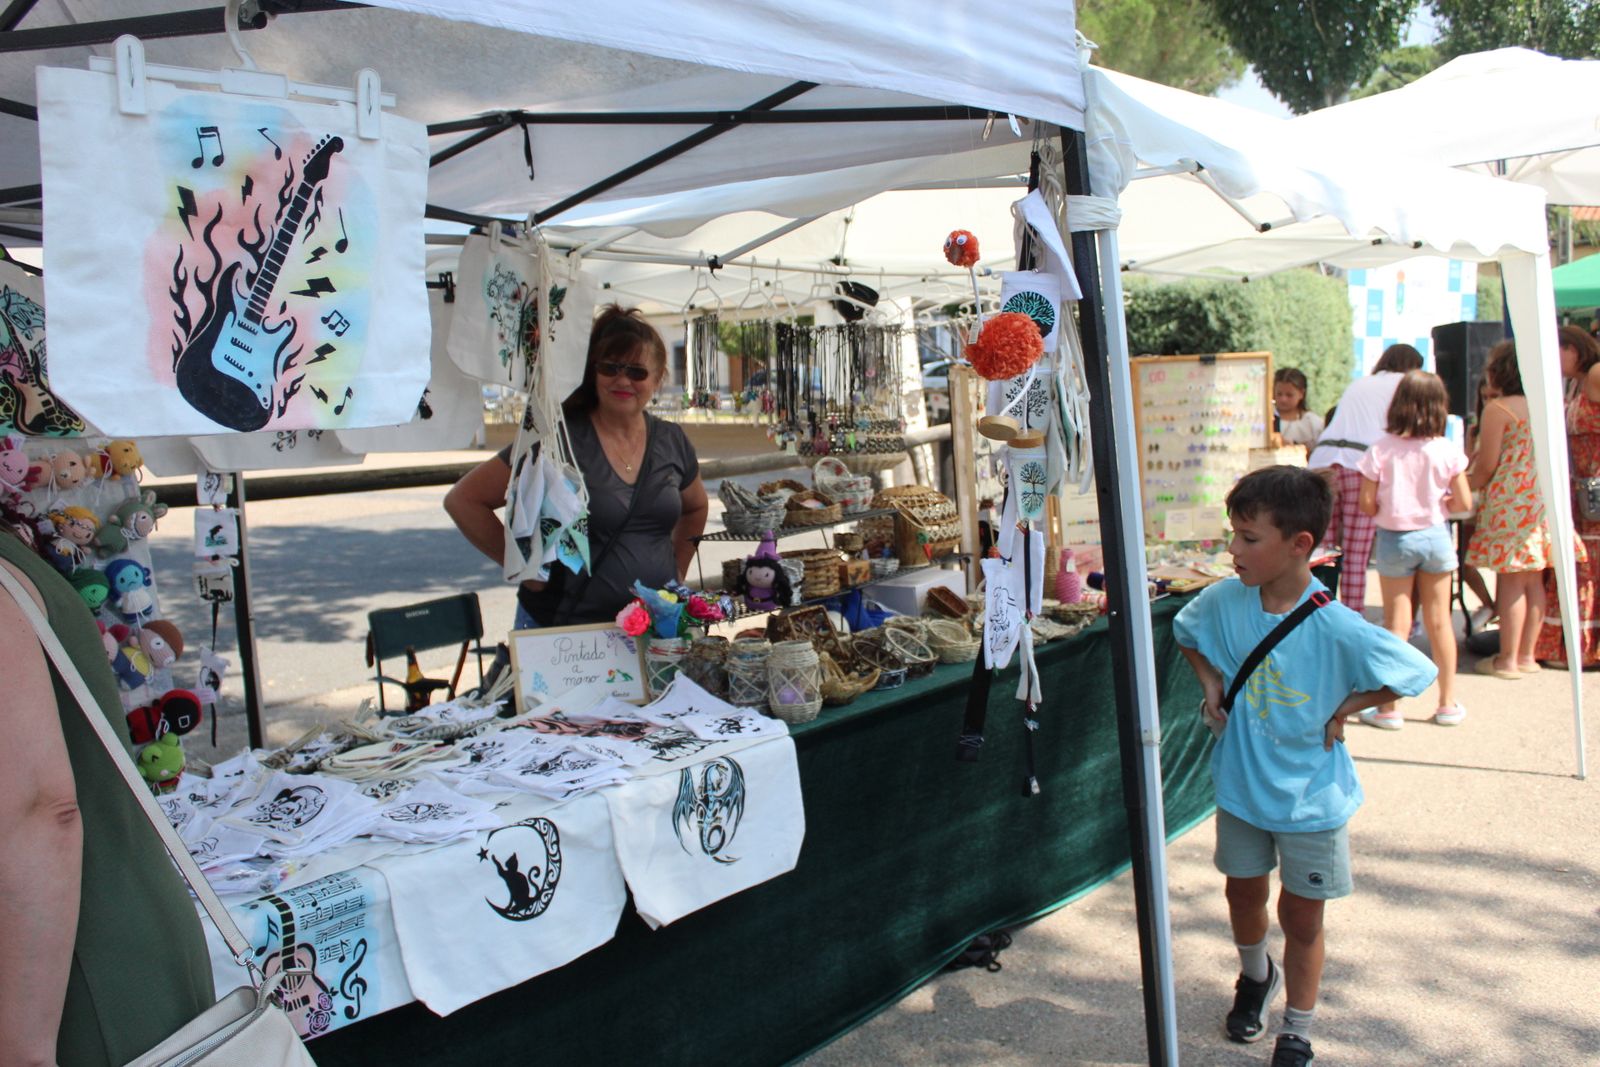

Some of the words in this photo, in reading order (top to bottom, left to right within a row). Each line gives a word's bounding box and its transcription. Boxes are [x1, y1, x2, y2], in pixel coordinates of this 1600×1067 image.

[551, 636, 606, 665] Pintado
[571, 664, 584, 674] a
[563, 674, 600, 687] mano
